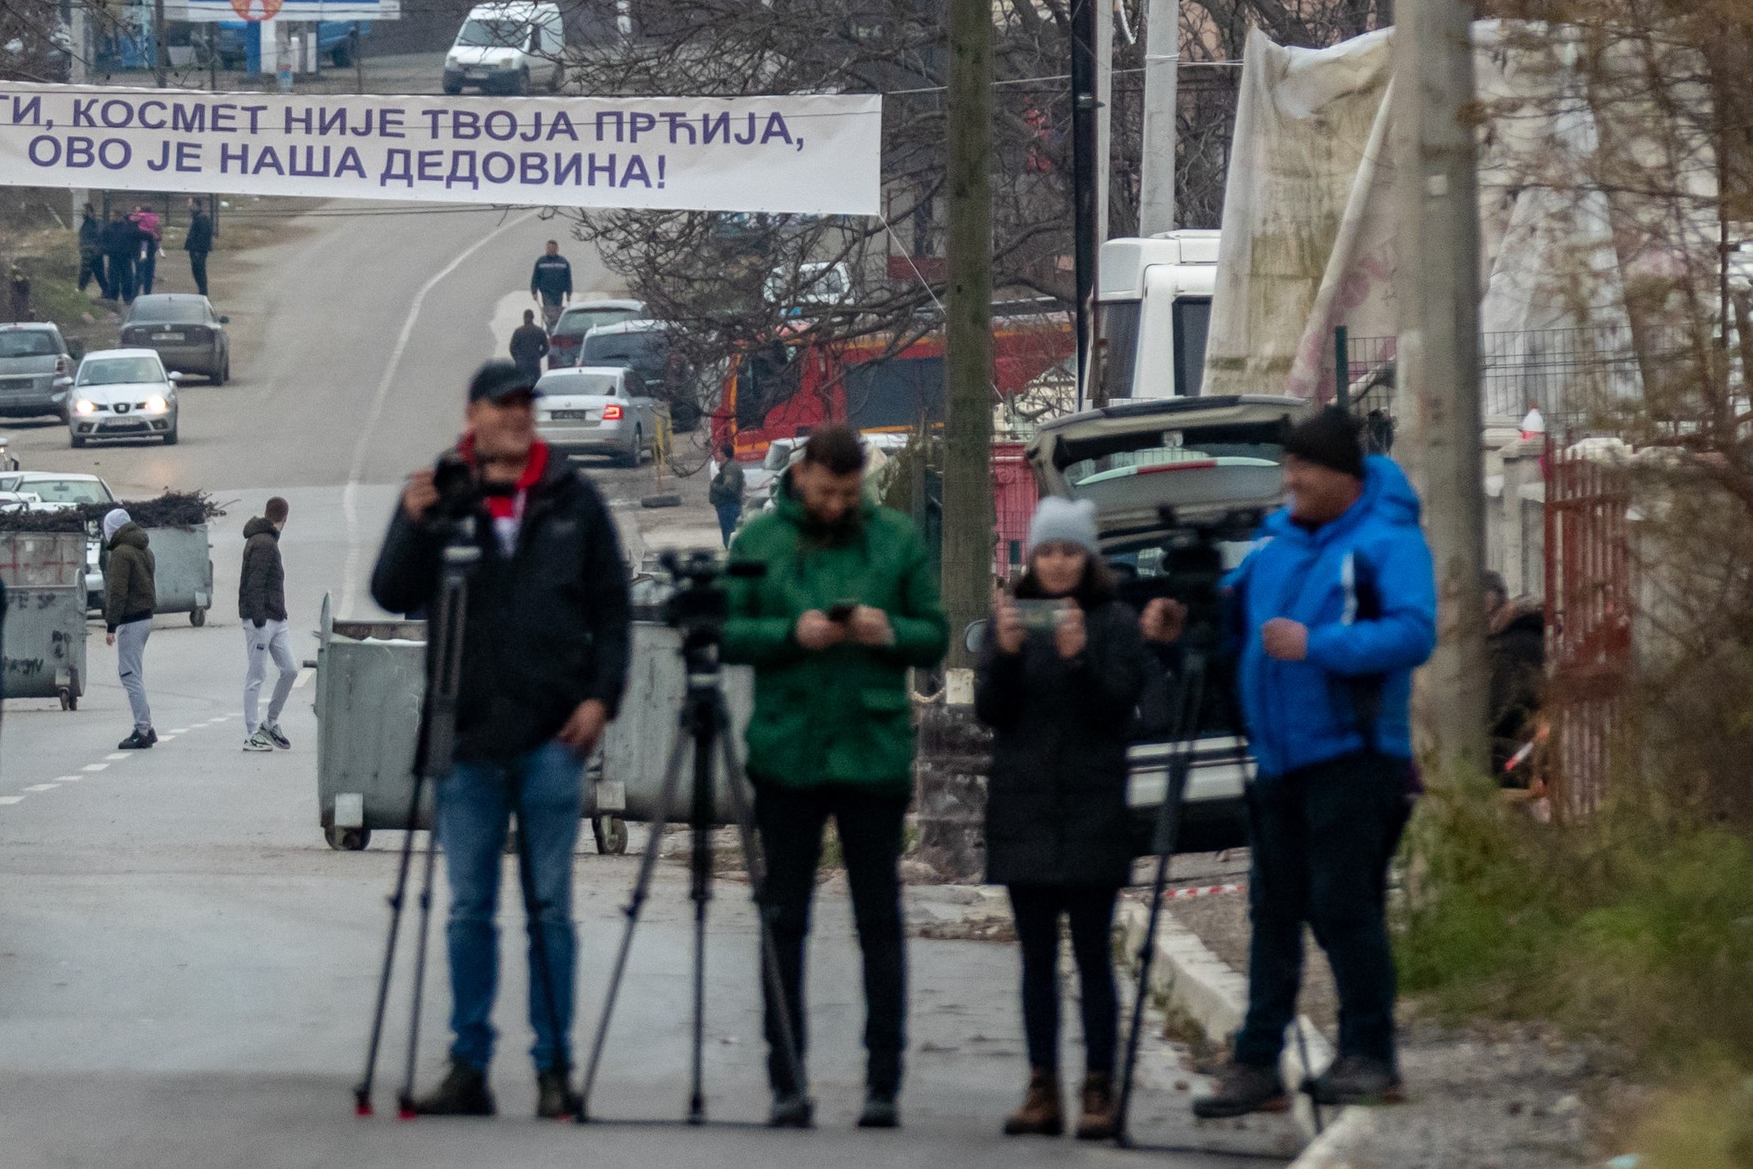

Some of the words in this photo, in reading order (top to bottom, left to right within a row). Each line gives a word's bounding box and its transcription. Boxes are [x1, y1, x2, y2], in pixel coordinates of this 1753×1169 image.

[73, 99, 267, 134] КОСМЕТ
[285, 106, 405, 138] НИЈЕ
[422, 109, 579, 141] ТВОЈА
[596, 111, 805, 152] ПРЋИЈА,
[28, 134, 132, 169] ОВО
[147, 142, 204, 173] ЈЕ
[220, 142, 368, 179] НАША
[379, 148, 667, 190] ДЕДОВИНА!
